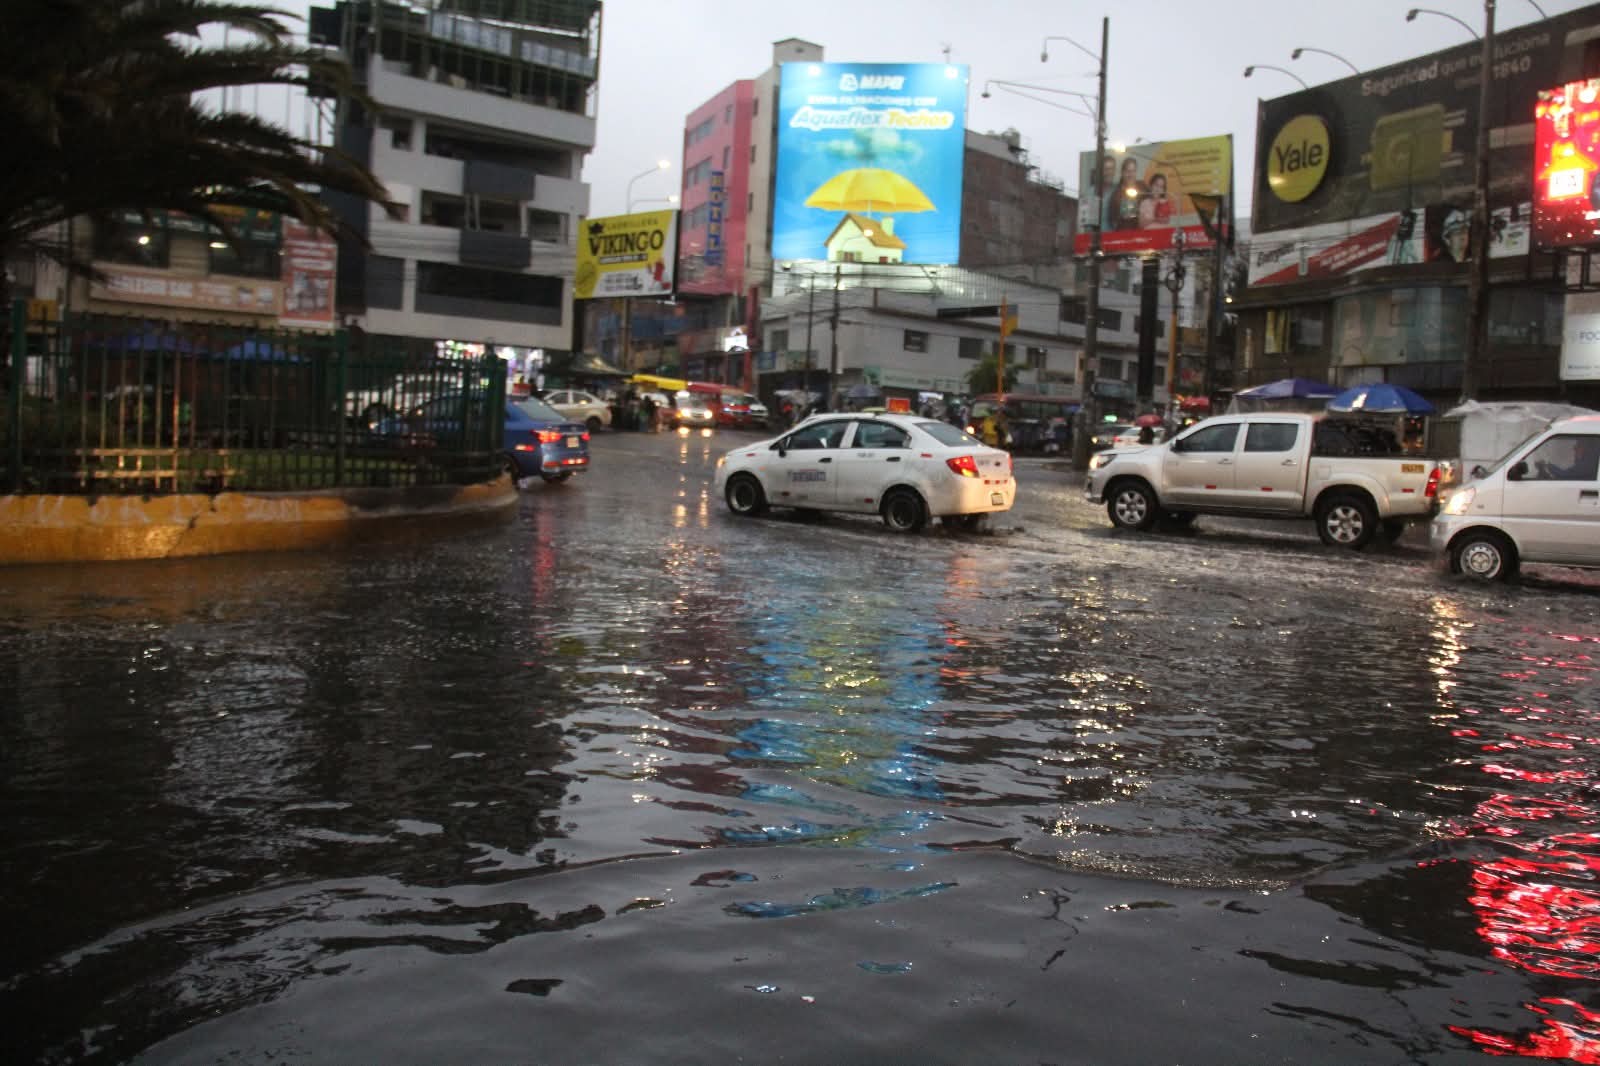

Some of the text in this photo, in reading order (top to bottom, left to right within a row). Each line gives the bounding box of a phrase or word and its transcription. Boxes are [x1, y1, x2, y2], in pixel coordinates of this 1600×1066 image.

[1361, 60, 1439, 97] Seguridad
[796, 107, 951, 130] Aquaflex Techos
[1275, 139, 1322, 174] Yale
[588, 229, 664, 257] VIKINGO
